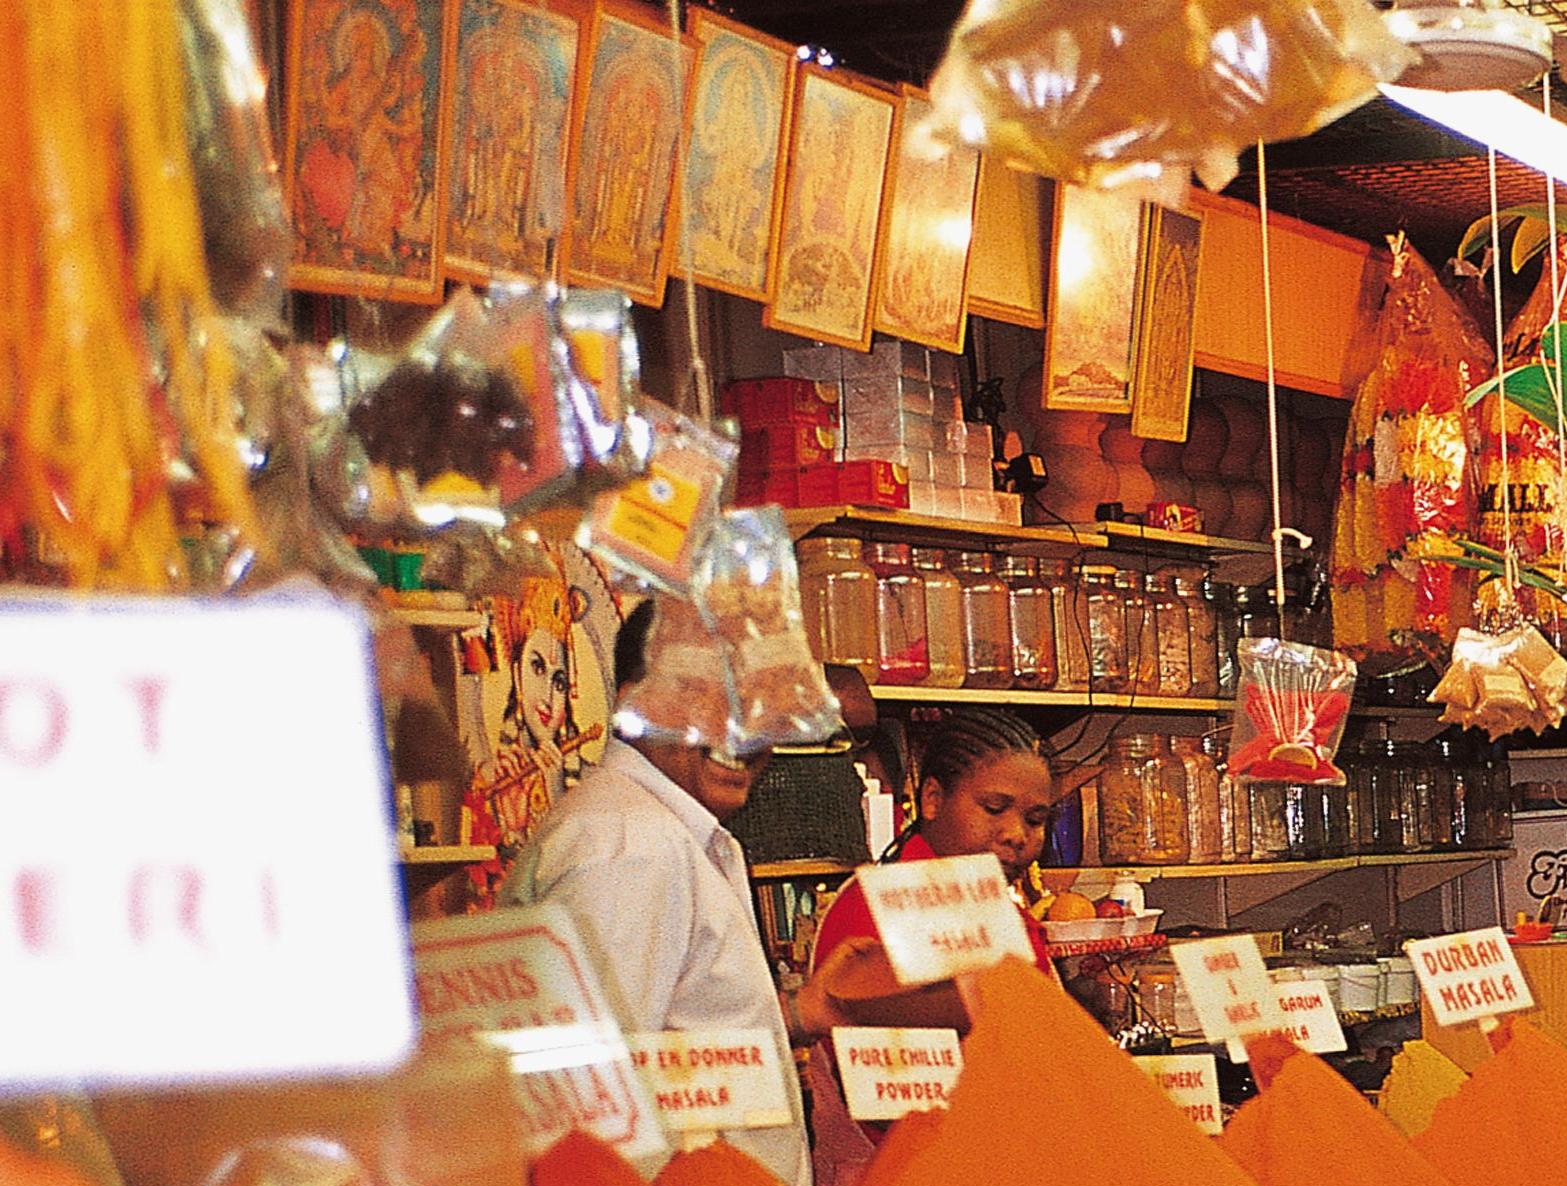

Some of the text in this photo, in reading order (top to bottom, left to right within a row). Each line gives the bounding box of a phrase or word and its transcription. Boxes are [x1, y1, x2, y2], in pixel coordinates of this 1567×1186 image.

[1423, 938, 1504, 976] DURBAN
[1279, 995, 1323, 1012] GARUM
[1439, 974, 1516, 1012] MASALA
[688, 1045, 763, 1068] DONNER
[849, 1047, 955, 1068] PURE CHILLIE
[656, 1087, 729, 1110] MASALA
[876, 1081, 947, 1101] POWDER
